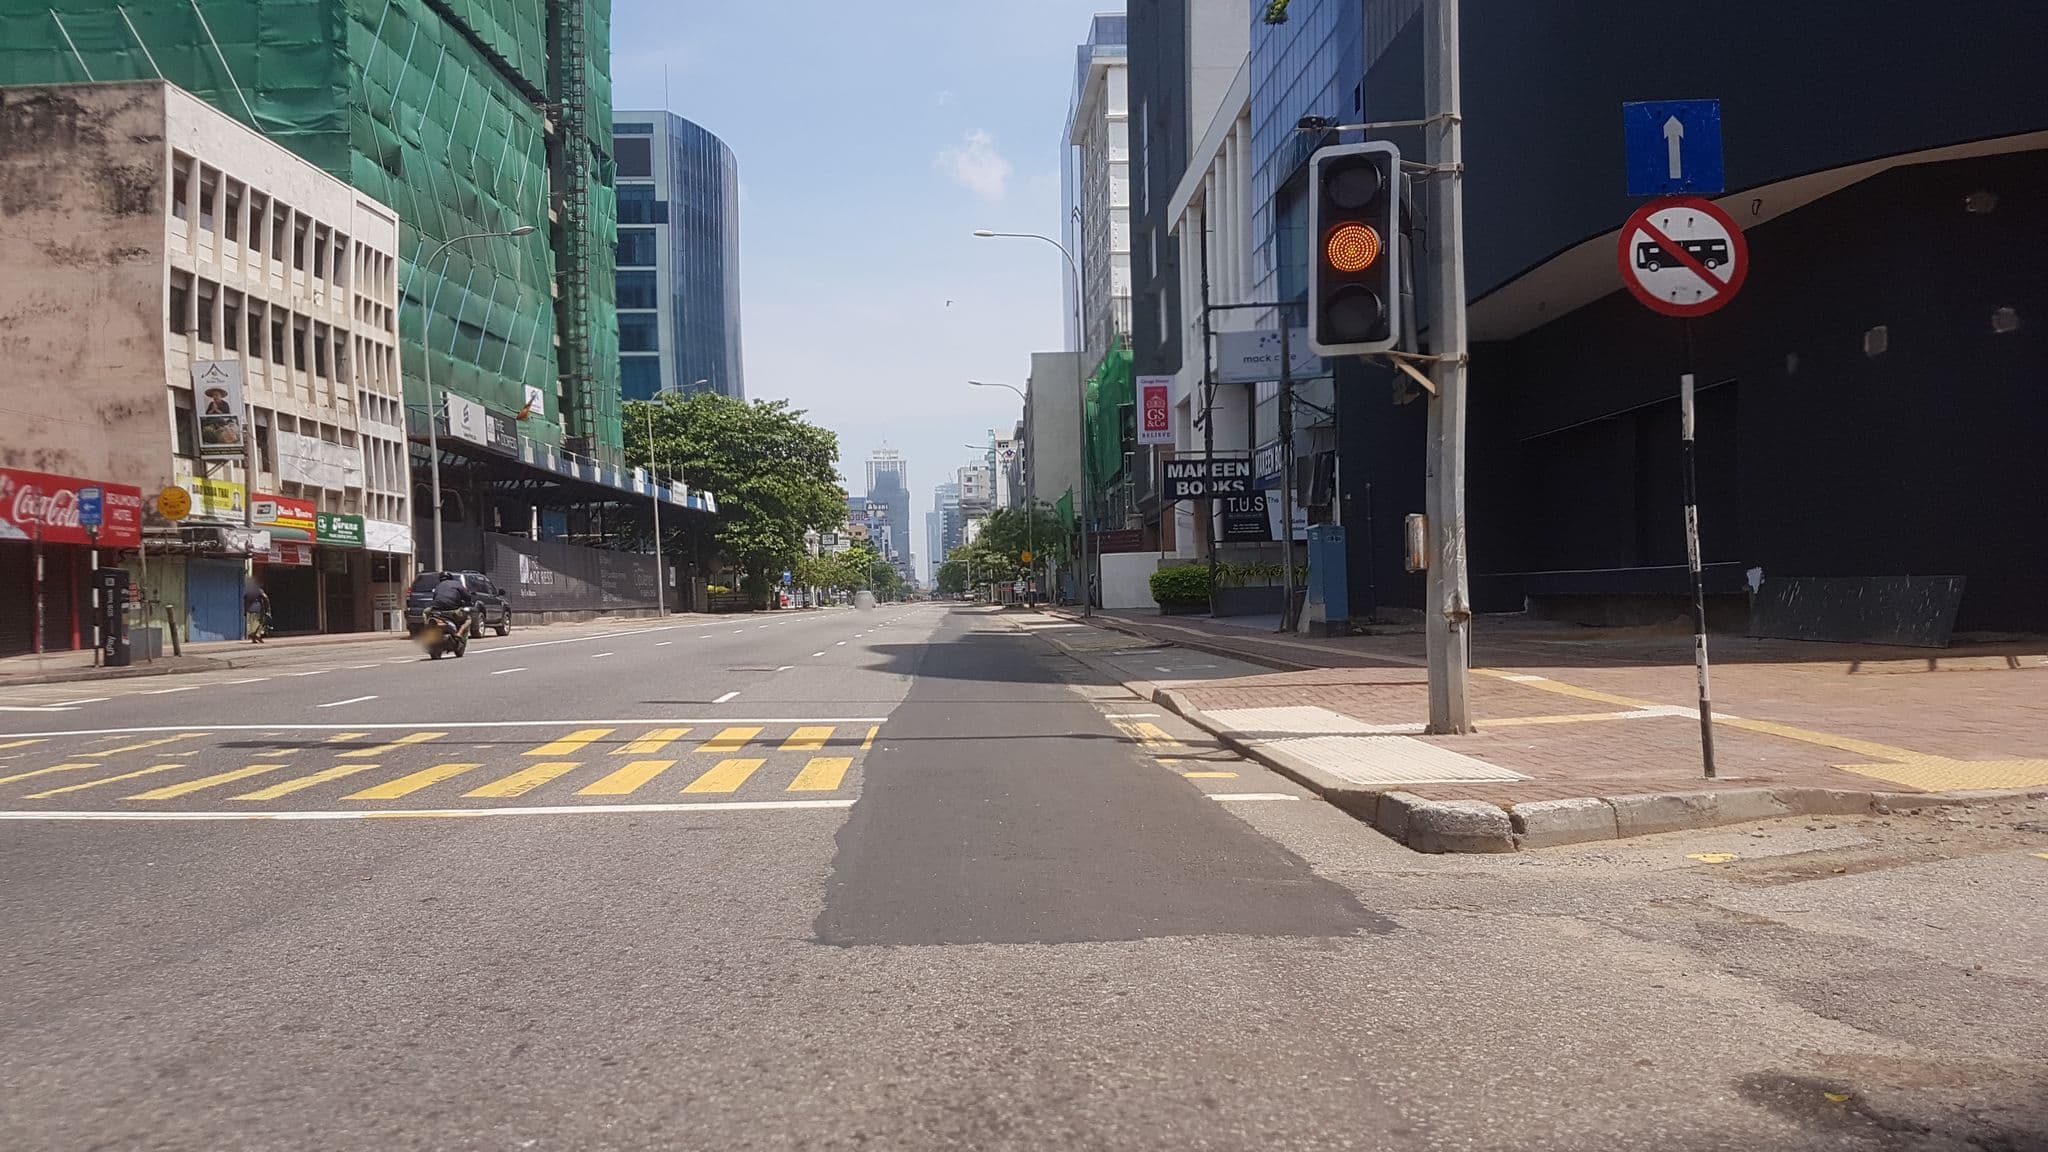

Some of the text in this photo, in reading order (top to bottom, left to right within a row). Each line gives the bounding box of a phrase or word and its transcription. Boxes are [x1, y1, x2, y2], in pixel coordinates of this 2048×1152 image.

[1243, 353, 1297, 364] mack ce
[1147, 408, 1165, 420] GS
[1167, 462, 1250, 478] MAKEEN
[1227, 496, 1264, 512] T.U.S
